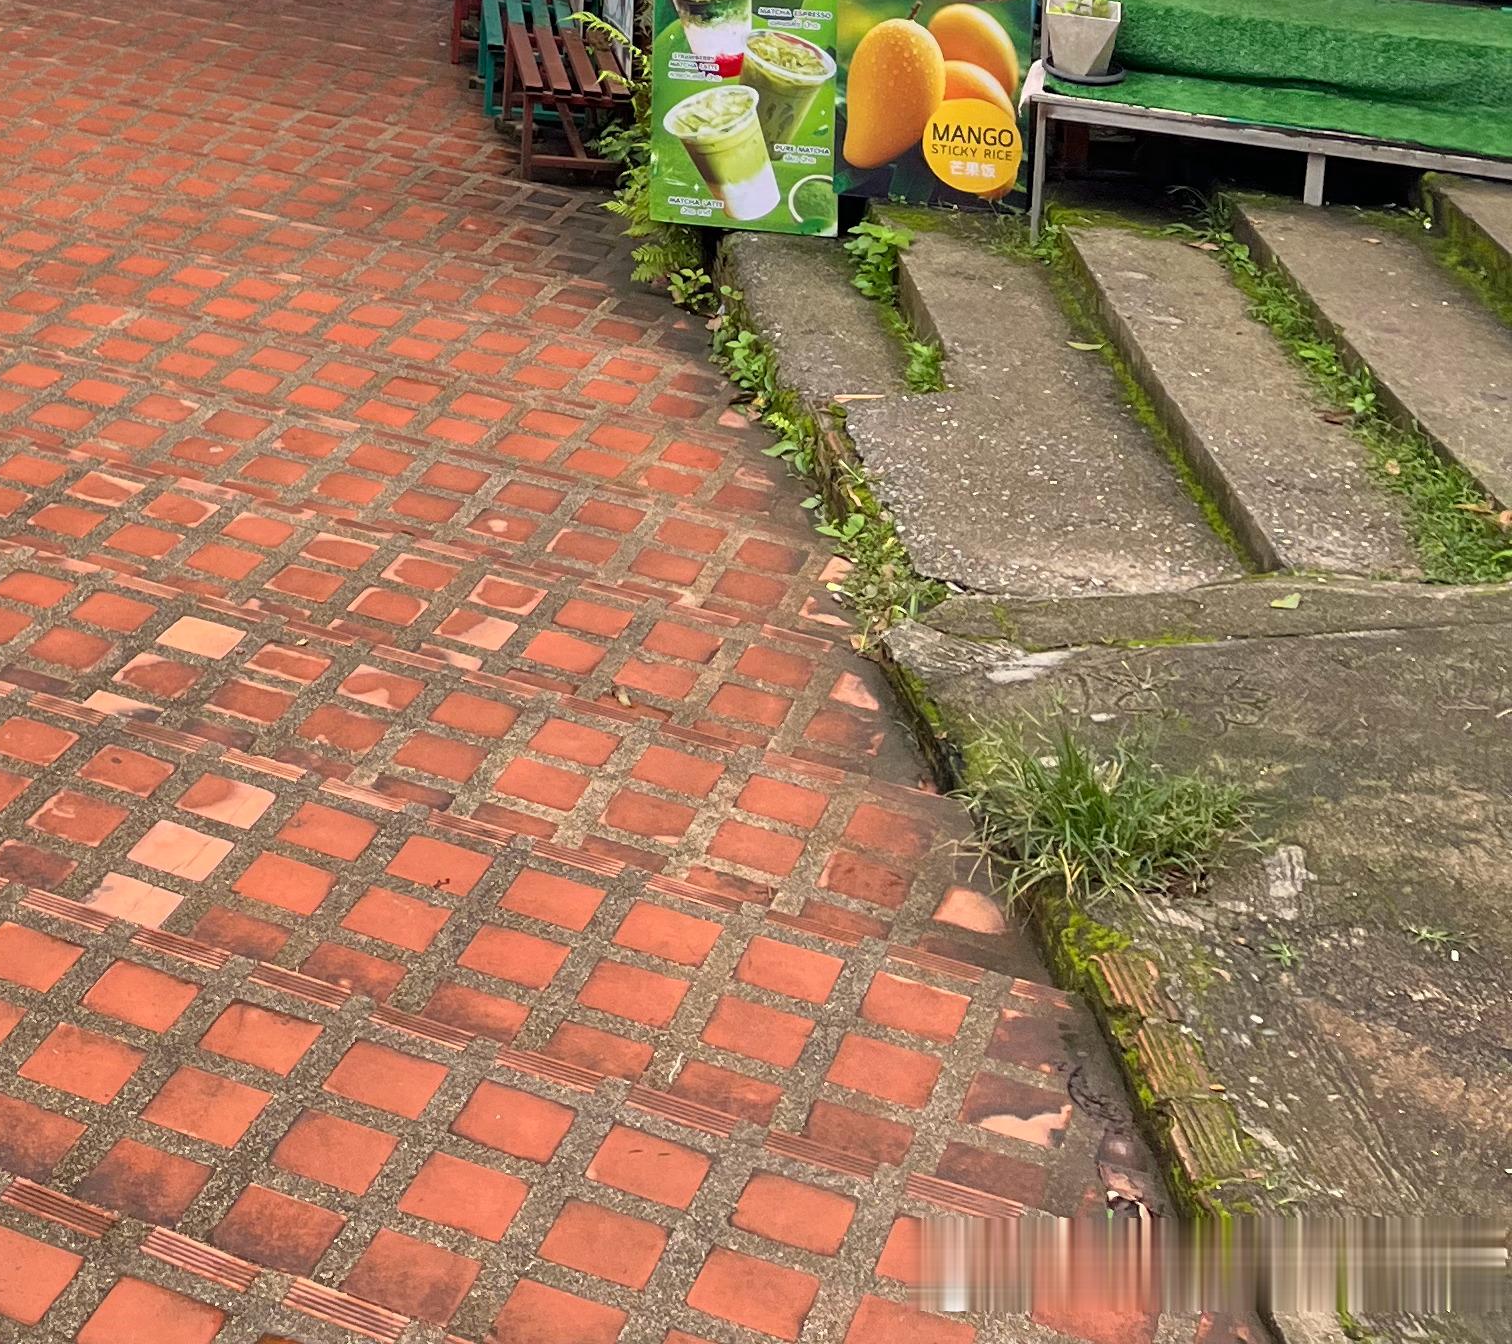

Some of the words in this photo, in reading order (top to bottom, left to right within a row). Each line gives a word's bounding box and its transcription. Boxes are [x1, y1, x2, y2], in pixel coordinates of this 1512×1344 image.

[759, 8, 791, 16] MATCHA
[794, 10, 831, 19] ESPRESSO
[932, 122, 1014, 148] MANGO
[931, 144, 978, 158] STICKY
[983, 148, 1013, 161] RICE
[669, 197, 700, 206] MATCHA
